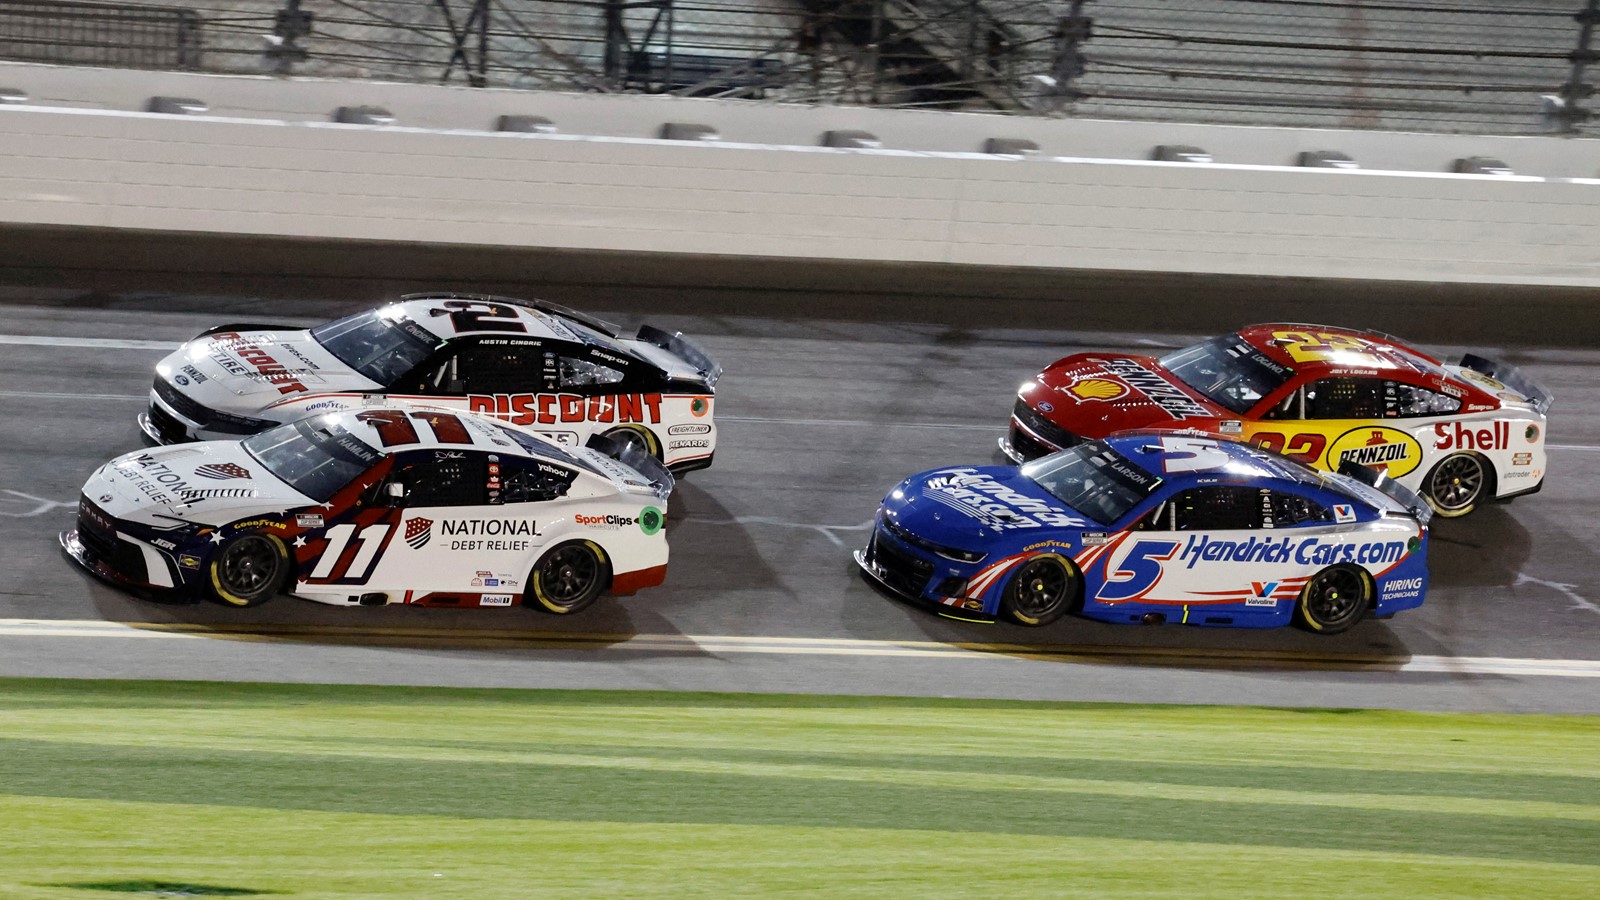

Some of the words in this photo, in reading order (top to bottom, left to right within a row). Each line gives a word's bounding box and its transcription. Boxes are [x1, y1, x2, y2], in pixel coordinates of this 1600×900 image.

[443, 301, 528, 333] 2
[212, 352, 243, 374] TIRE
[590, 349, 629, 366] Snap-on
[1251, 354, 1284, 373] LOGANO
[468, 393, 662, 425] DISCOUNT
[355, 410, 474, 447] 11
[670, 425, 708, 434] FREIGHTLINER
[1434, 422, 1509, 450] Shell
[337, 437, 375, 461] HAMLIN
[669, 439, 709, 449] MENARDS
[1339, 443, 1408, 464] PENNZOIL
[537, 463, 569, 478] yahoo!
[1111, 463, 1148, 484] LARSON
[135, 481, 172, 505] RELIEF
[81, 502, 112, 528] CAMRY
[575, 514, 632, 527] SportClips
[234, 519, 287, 530] GOODYEAR
[441, 519, 542, 537] NATIONAL
[150, 538, 176, 550] JGR
[309, 523, 392, 580] 11
[451, 540, 484, 551] DEBT
[486, 541, 529, 551] RELIEF
[1023, 540, 1072, 552] GOODYEAR
[1095, 540, 1181, 600] 5
[1383, 578, 1422, 592] HIRING
[483, 596, 502, 604] Mobil
[1382, 590, 1419, 600] TECHNICIANS
